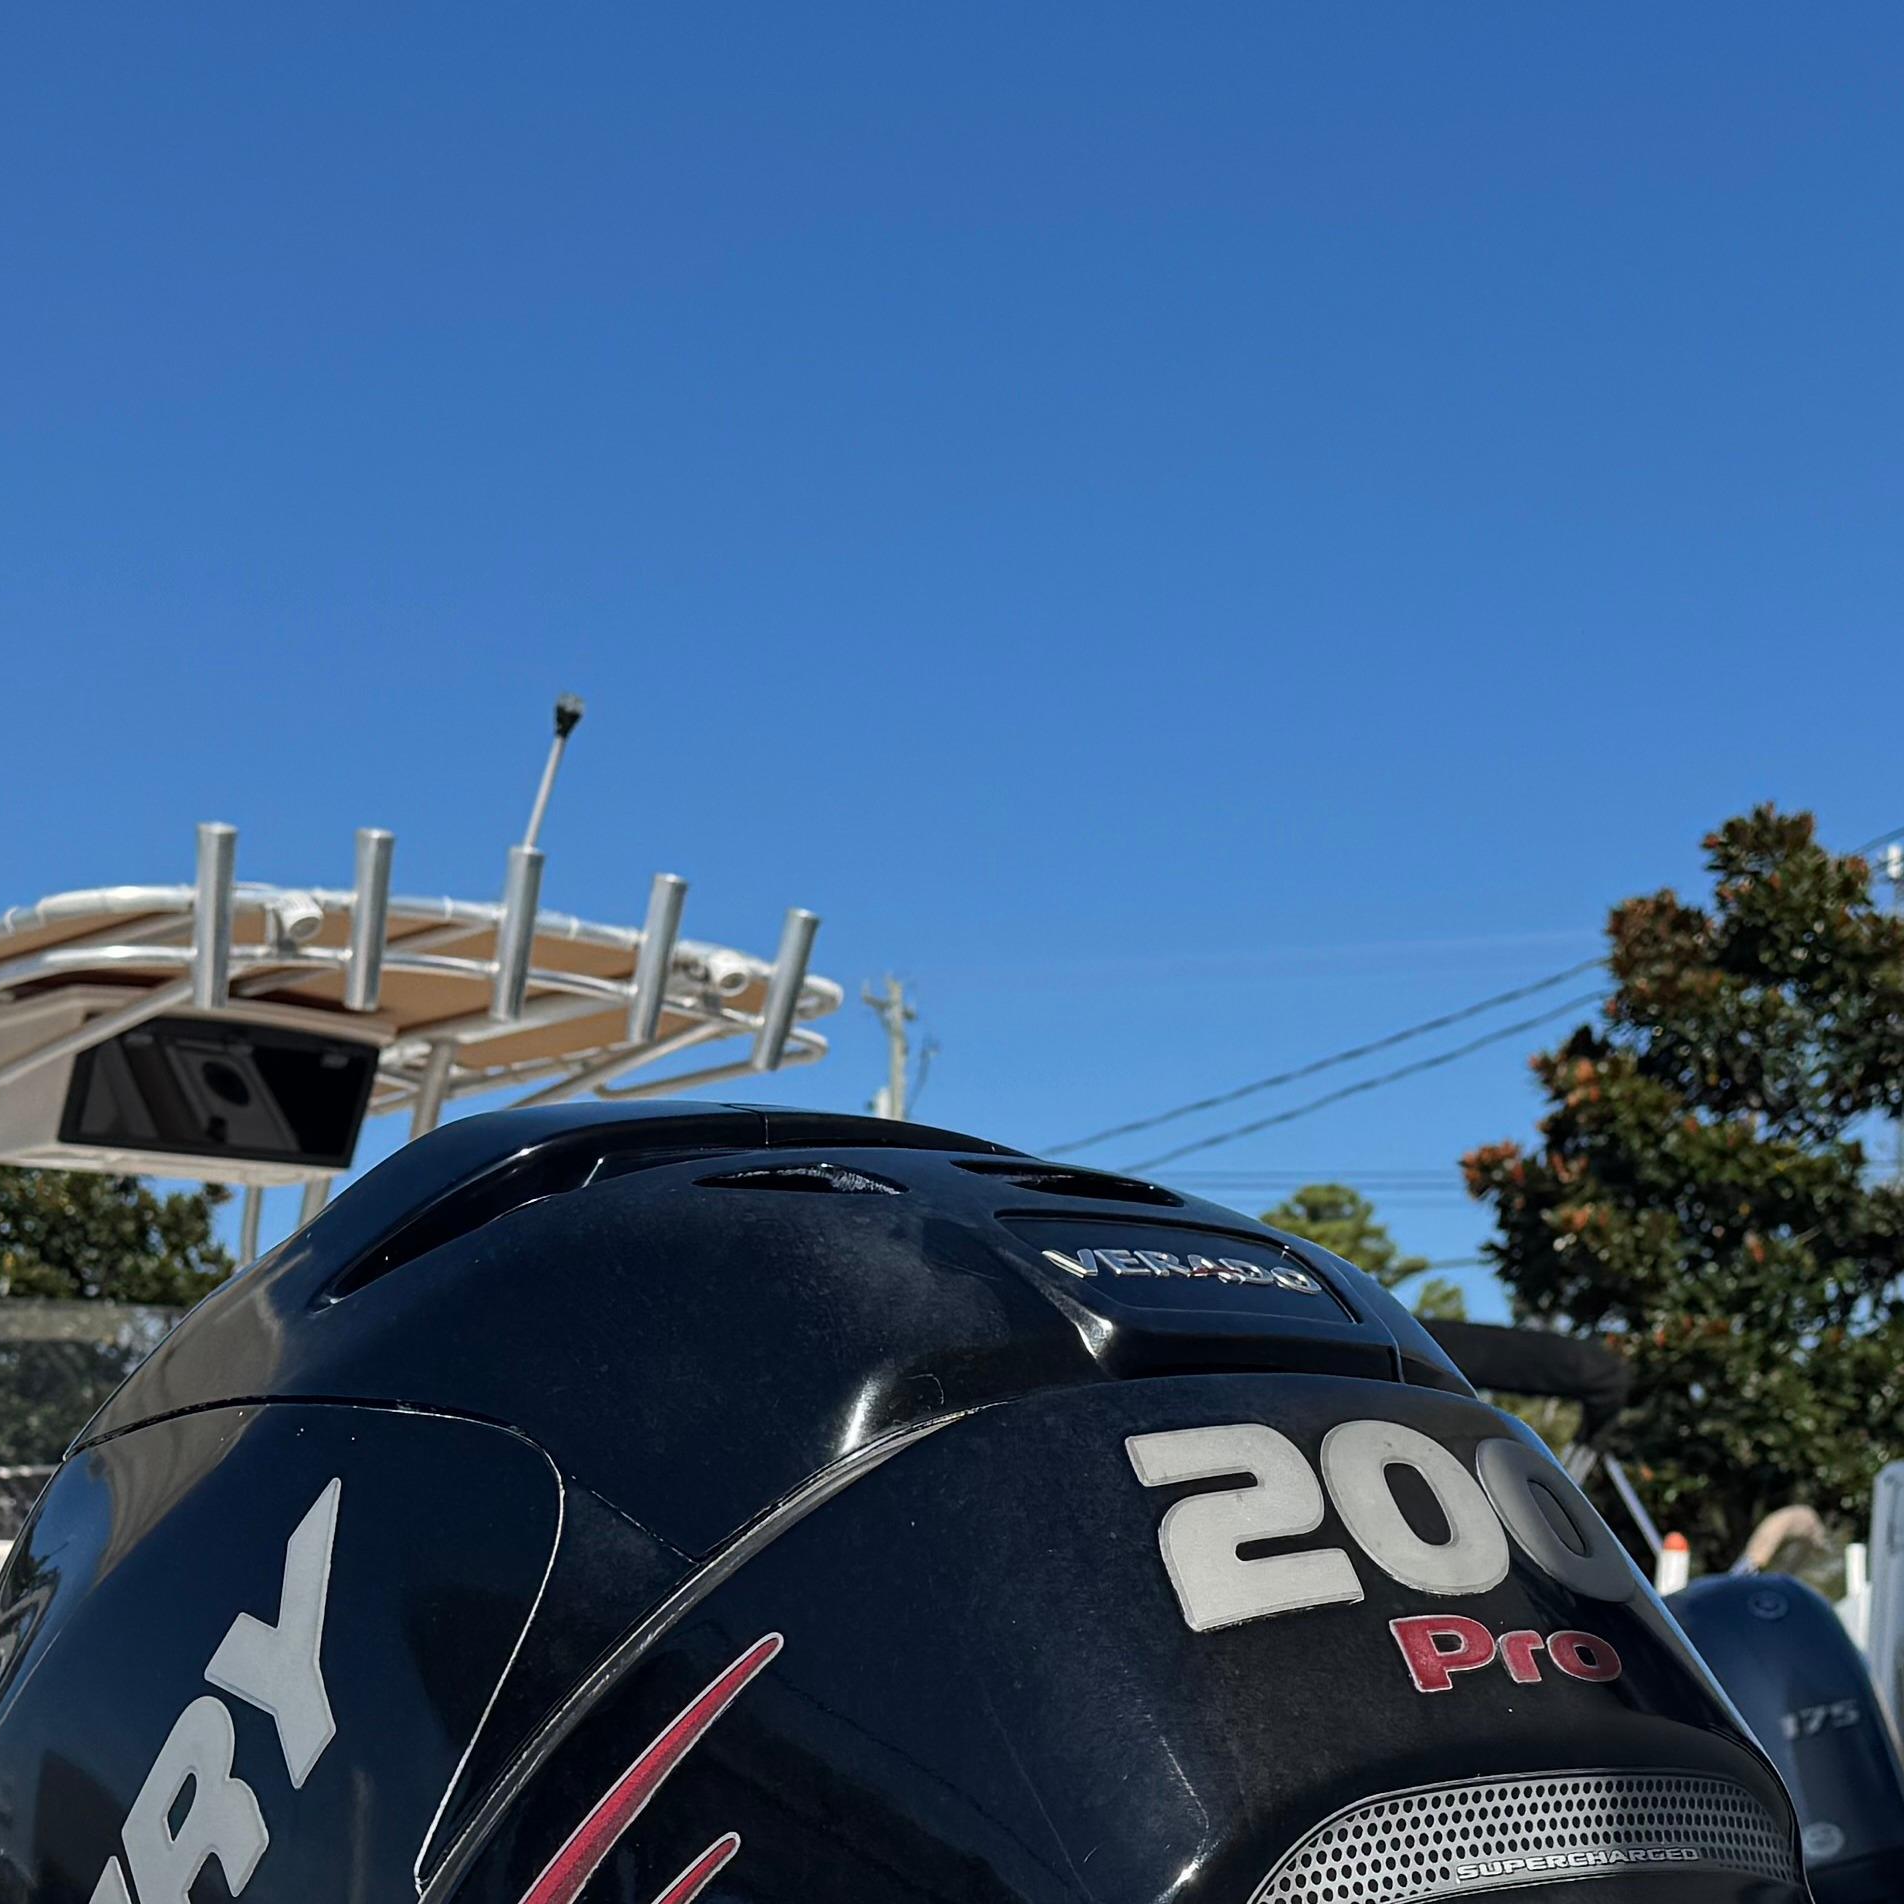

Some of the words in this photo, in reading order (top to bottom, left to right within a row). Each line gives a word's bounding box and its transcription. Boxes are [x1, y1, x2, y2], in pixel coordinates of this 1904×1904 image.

[1042, 1247, 1323, 1295] VERADO
[1124, 1419, 1637, 1632] 200
[1388, 1613, 1623, 1693] Pro
[1780, 1700, 1860, 1739] 175
[1454, 1847, 1701, 1885] SUPERCHARGED
